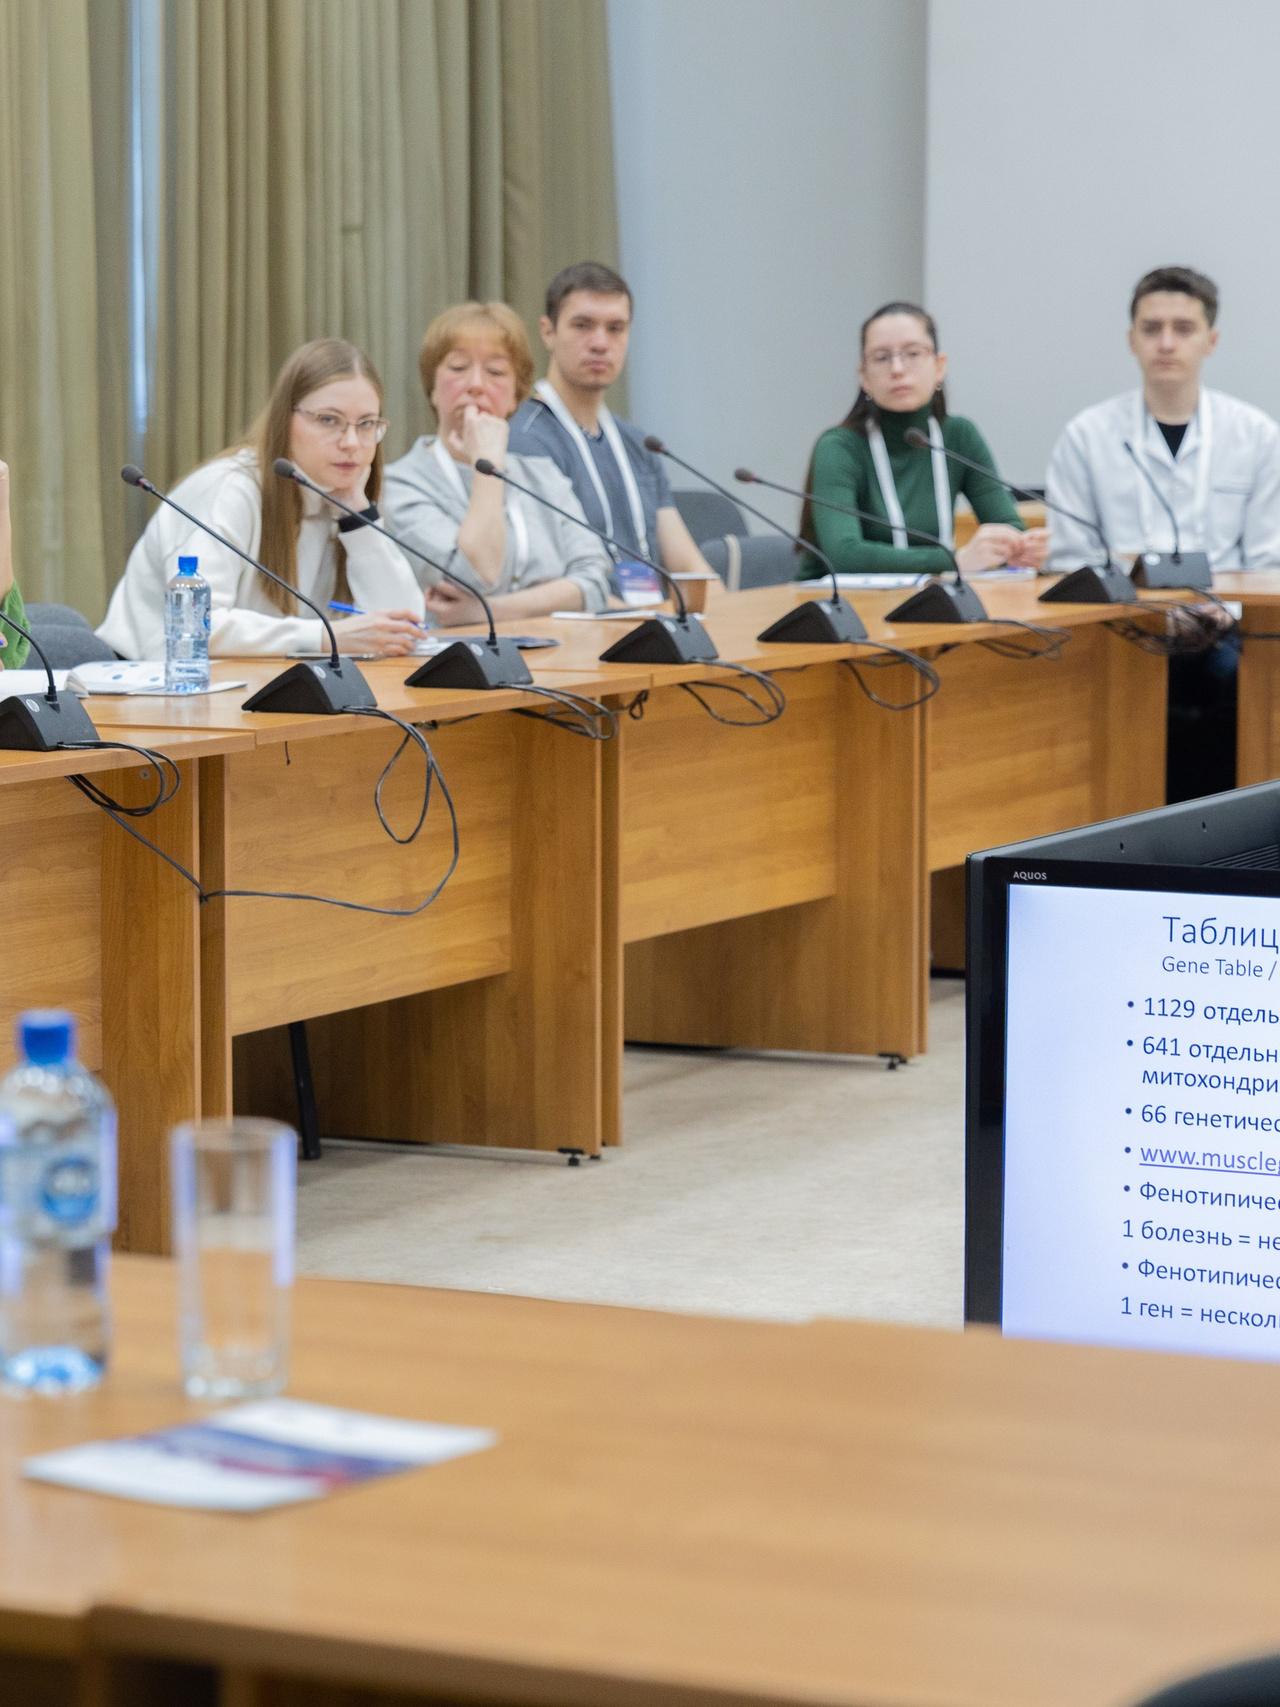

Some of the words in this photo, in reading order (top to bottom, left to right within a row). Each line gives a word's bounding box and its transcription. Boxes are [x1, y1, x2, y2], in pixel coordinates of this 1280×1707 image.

[1012, 871, 1047, 881] AQUOS
[1162, 916, 1279, 955] Таблиц
[1161, 955, 1210, 975] Gene
[1214, 958, 1263, 978] Table
[1144, 997, 1196, 1019] 1129
[1203, 1005, 1280, 1026] отдель
[1142, 1035, 1181, 1057] 641
[1188, 1043, 1278, 1064] отдельн
[1142, 1069, 1279, 1096] митохондри
[1141, 1104, 1167, 1124] 66
[1138, 1147, 1280, 1177] www.muscle
[1123, 1219, 1134, 1238] 1
[1141, 1220, 1233, 1247] болезнь
[1238, 1234, 1251, 1244] =
[1121, 1296, 1132, 1315] 1
[1139, 1302, 1173, 1319] ген
[1180, 1307, 1193, 1317] =
[1200, 1308, 1280, 1329] нескол
